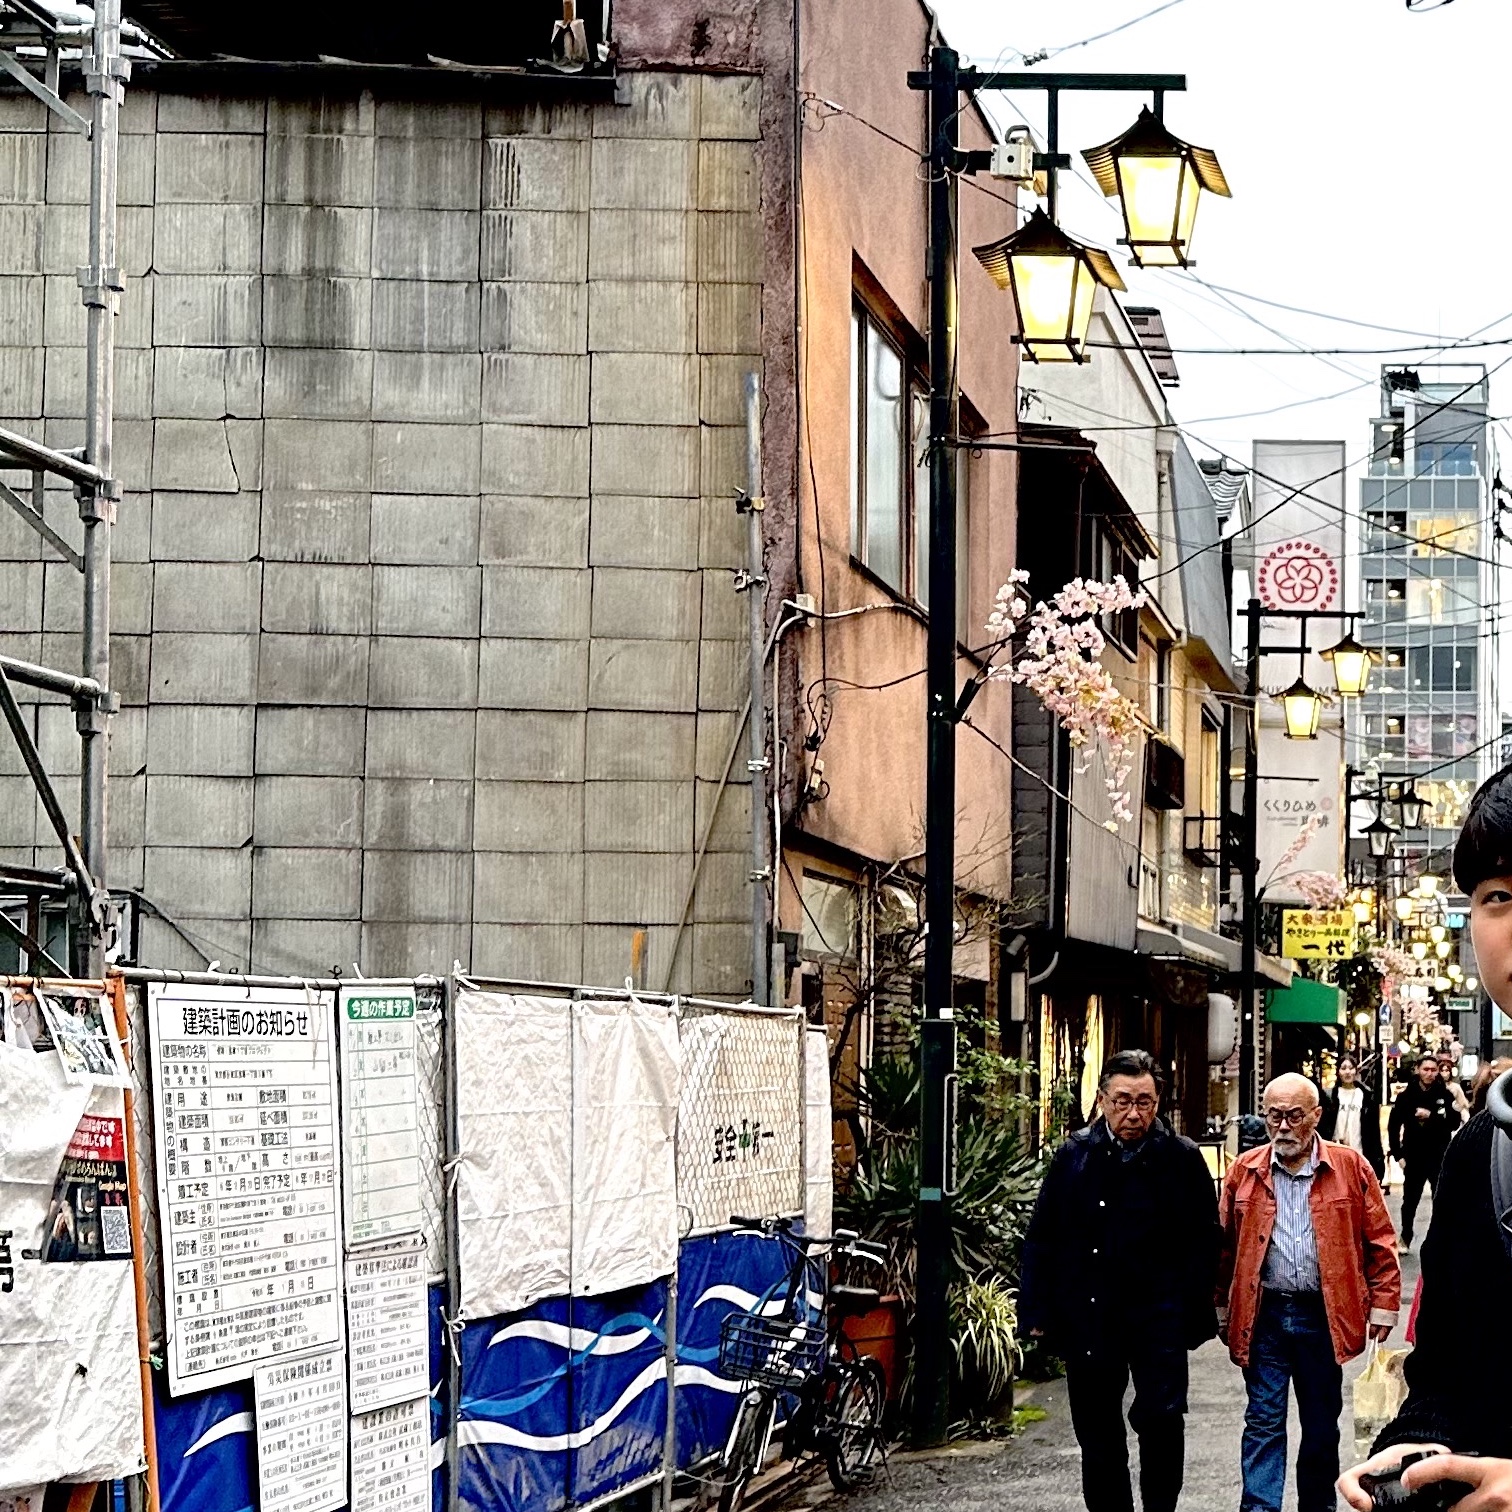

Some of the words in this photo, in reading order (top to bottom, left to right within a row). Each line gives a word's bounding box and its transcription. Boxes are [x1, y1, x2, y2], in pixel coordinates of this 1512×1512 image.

[1263, 799, 1317, 812] くくりひめ
[1301, 940, 1346, 956] 一代
[183, 1007, 308, 1036] 建築計画のお知らせ
